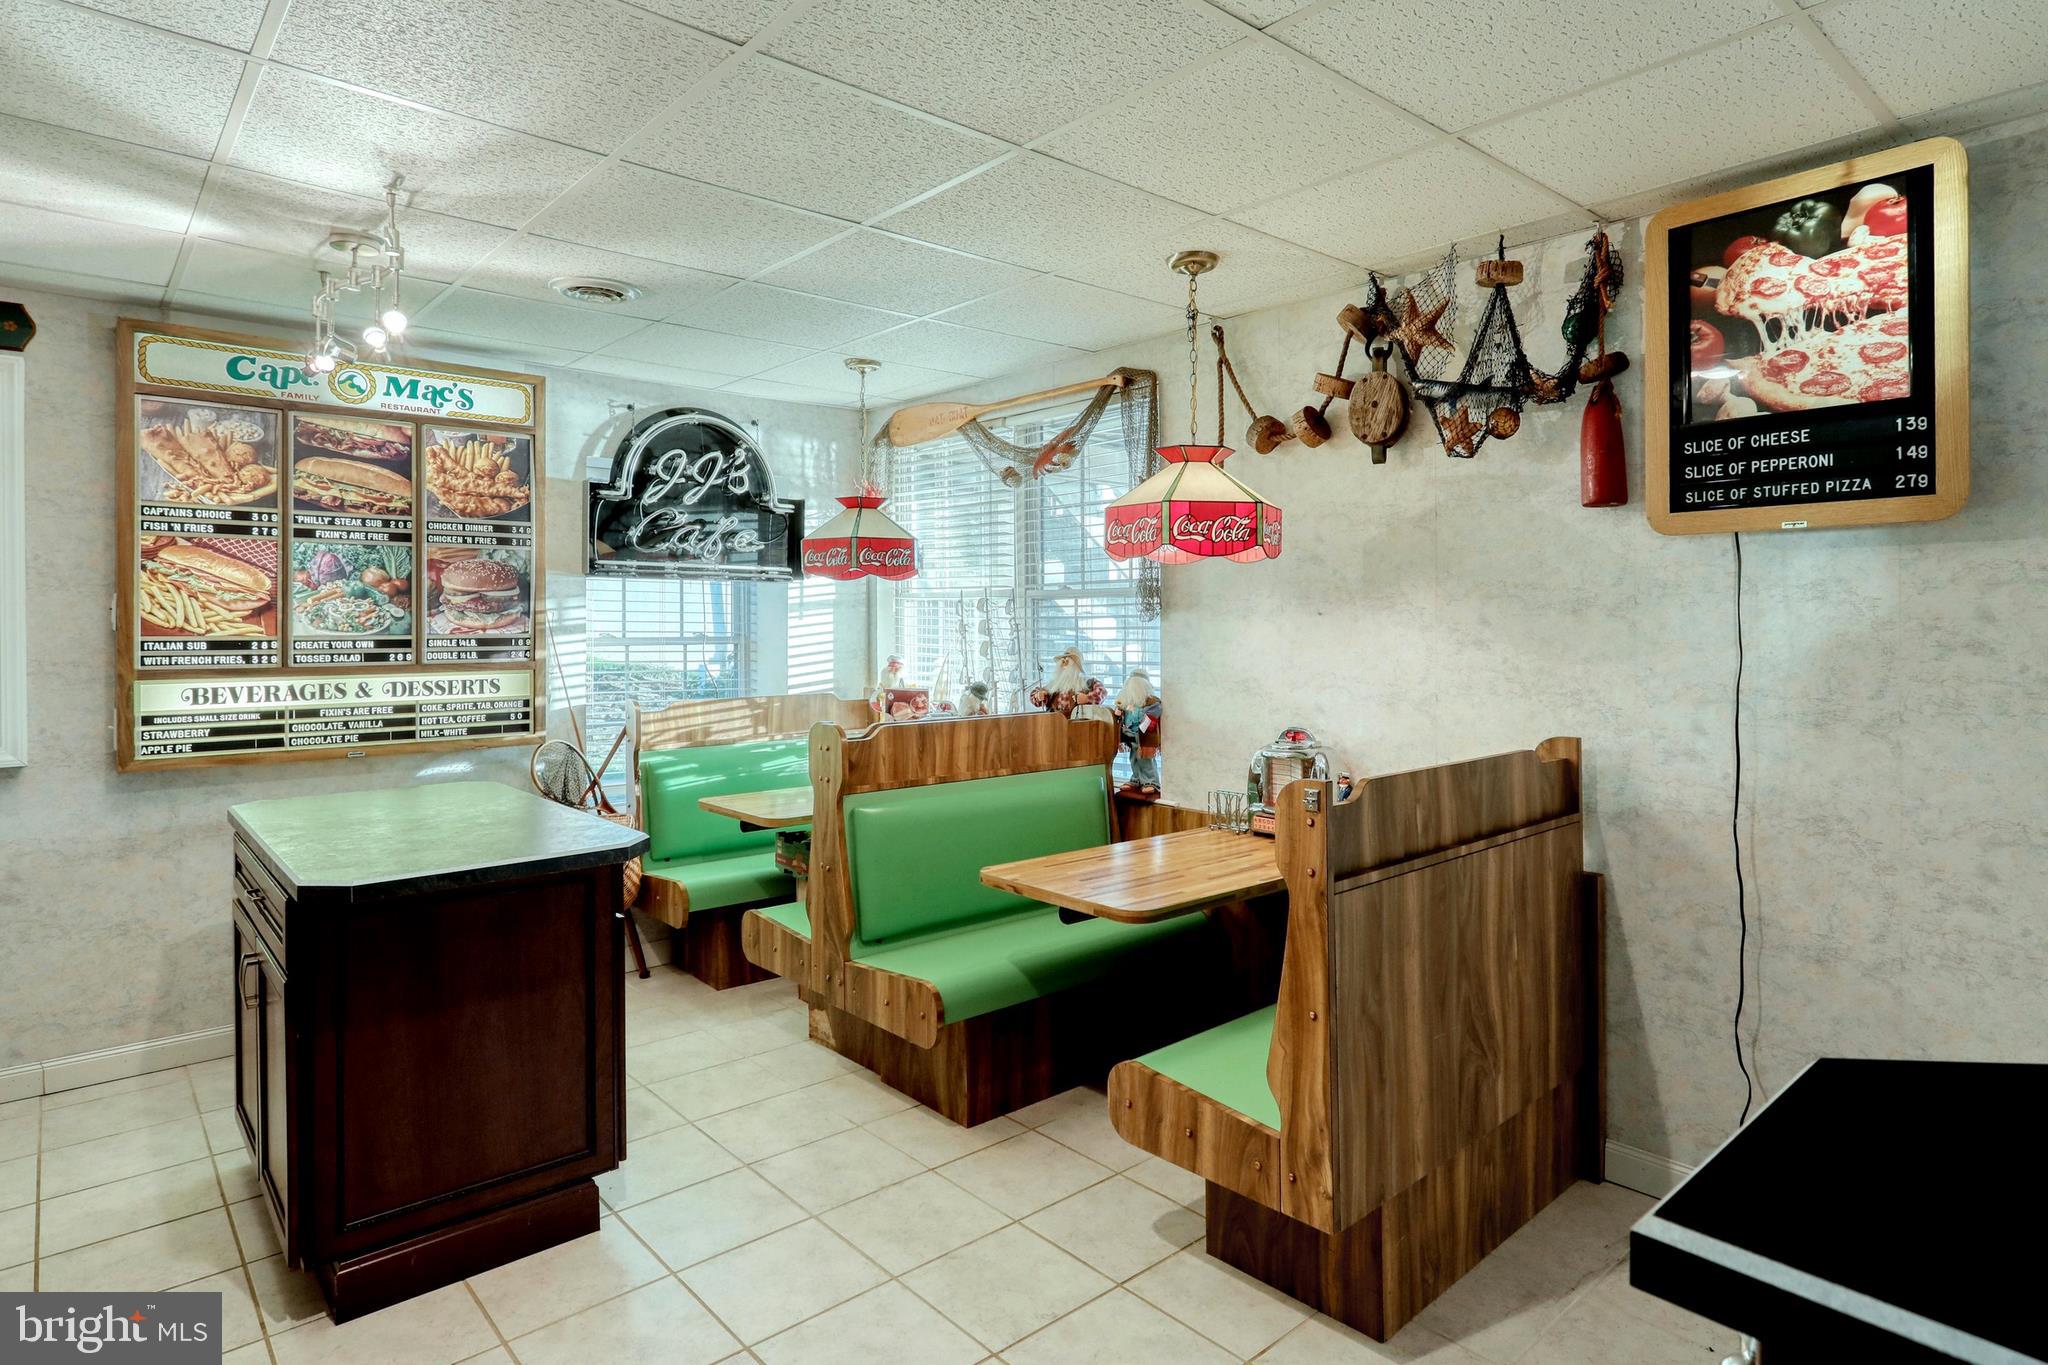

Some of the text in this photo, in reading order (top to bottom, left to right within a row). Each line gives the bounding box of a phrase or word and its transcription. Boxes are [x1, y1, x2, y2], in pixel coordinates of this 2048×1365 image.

[383, 376, 474, 410] Mac's
[280, 392, 441, 414] FAMILY RESTAURANT
[1684, 439, 1723, 455] SLICE
[1728, 436, 1746, 451] OF
[1750, 430, 1810, 448] CHEESE
[1684, 465, 1724, 480] SLICE
[1728, 462, 1746, 476] OF
[1751, 453, 1834, 474] PEPPERONI
[1685, 489, 1724, 503] SLICE
[1730, 487, 1747, 500] OF
[1753, 482, 1820, 498] STUFFED
[1826, 478, 1872, 493] PIZZA
[143, 507, 193, 518] CAPTAINS
[196, 510, 233, 520] CHOICE
[334, 517, 362, 526] STEAK
[365, 519, 382, 527] SUB
[428, 522, 463, 531] CHICKEN
[464, 524, 494, 532] DINNER
[143, 522, 168, 531] FISH
[184, 524, 214, 533] FRIES
[315, 530, 389, 540] FIXIN'S ARE FREE
[428, 535, 463, 543] CHICKEN
[475, 537, 497, 545] FRIES
[143, 642, 183, 650] ITALIAN
[186, 642, 207, 650] SUB
[295, 641, 330, 649] CREATE
[143, 657, 169, 665] WITH
[171, 656, 212, 665] FRENCH
[295, 655, 331, 663] TOSSED
[333, 654, 361, 662] SALAD
[427, 652, 458, 660] DOUBLE
[181, 678, 501, 706] BEVERAGES & DESSERTS
[494, 700, 523, 708] ORANGE
[320, 706, 394, 717] FIXIN'S ARE FREE
[154, 716, 192, 724] INCLUDES
[348, 720, 383, 729] VANILLA
[421, 717, 438, 725] HOT
[457, 715, 486, 723] COFFEE
[143, 728, 210, 740] STRAWBERRY
[421, 728, 468, 737] MILK-WHITE
[290, 734, 359, 746] CHOCOLATE PIE
[141, 744, 192, 755] APPLE PIE
